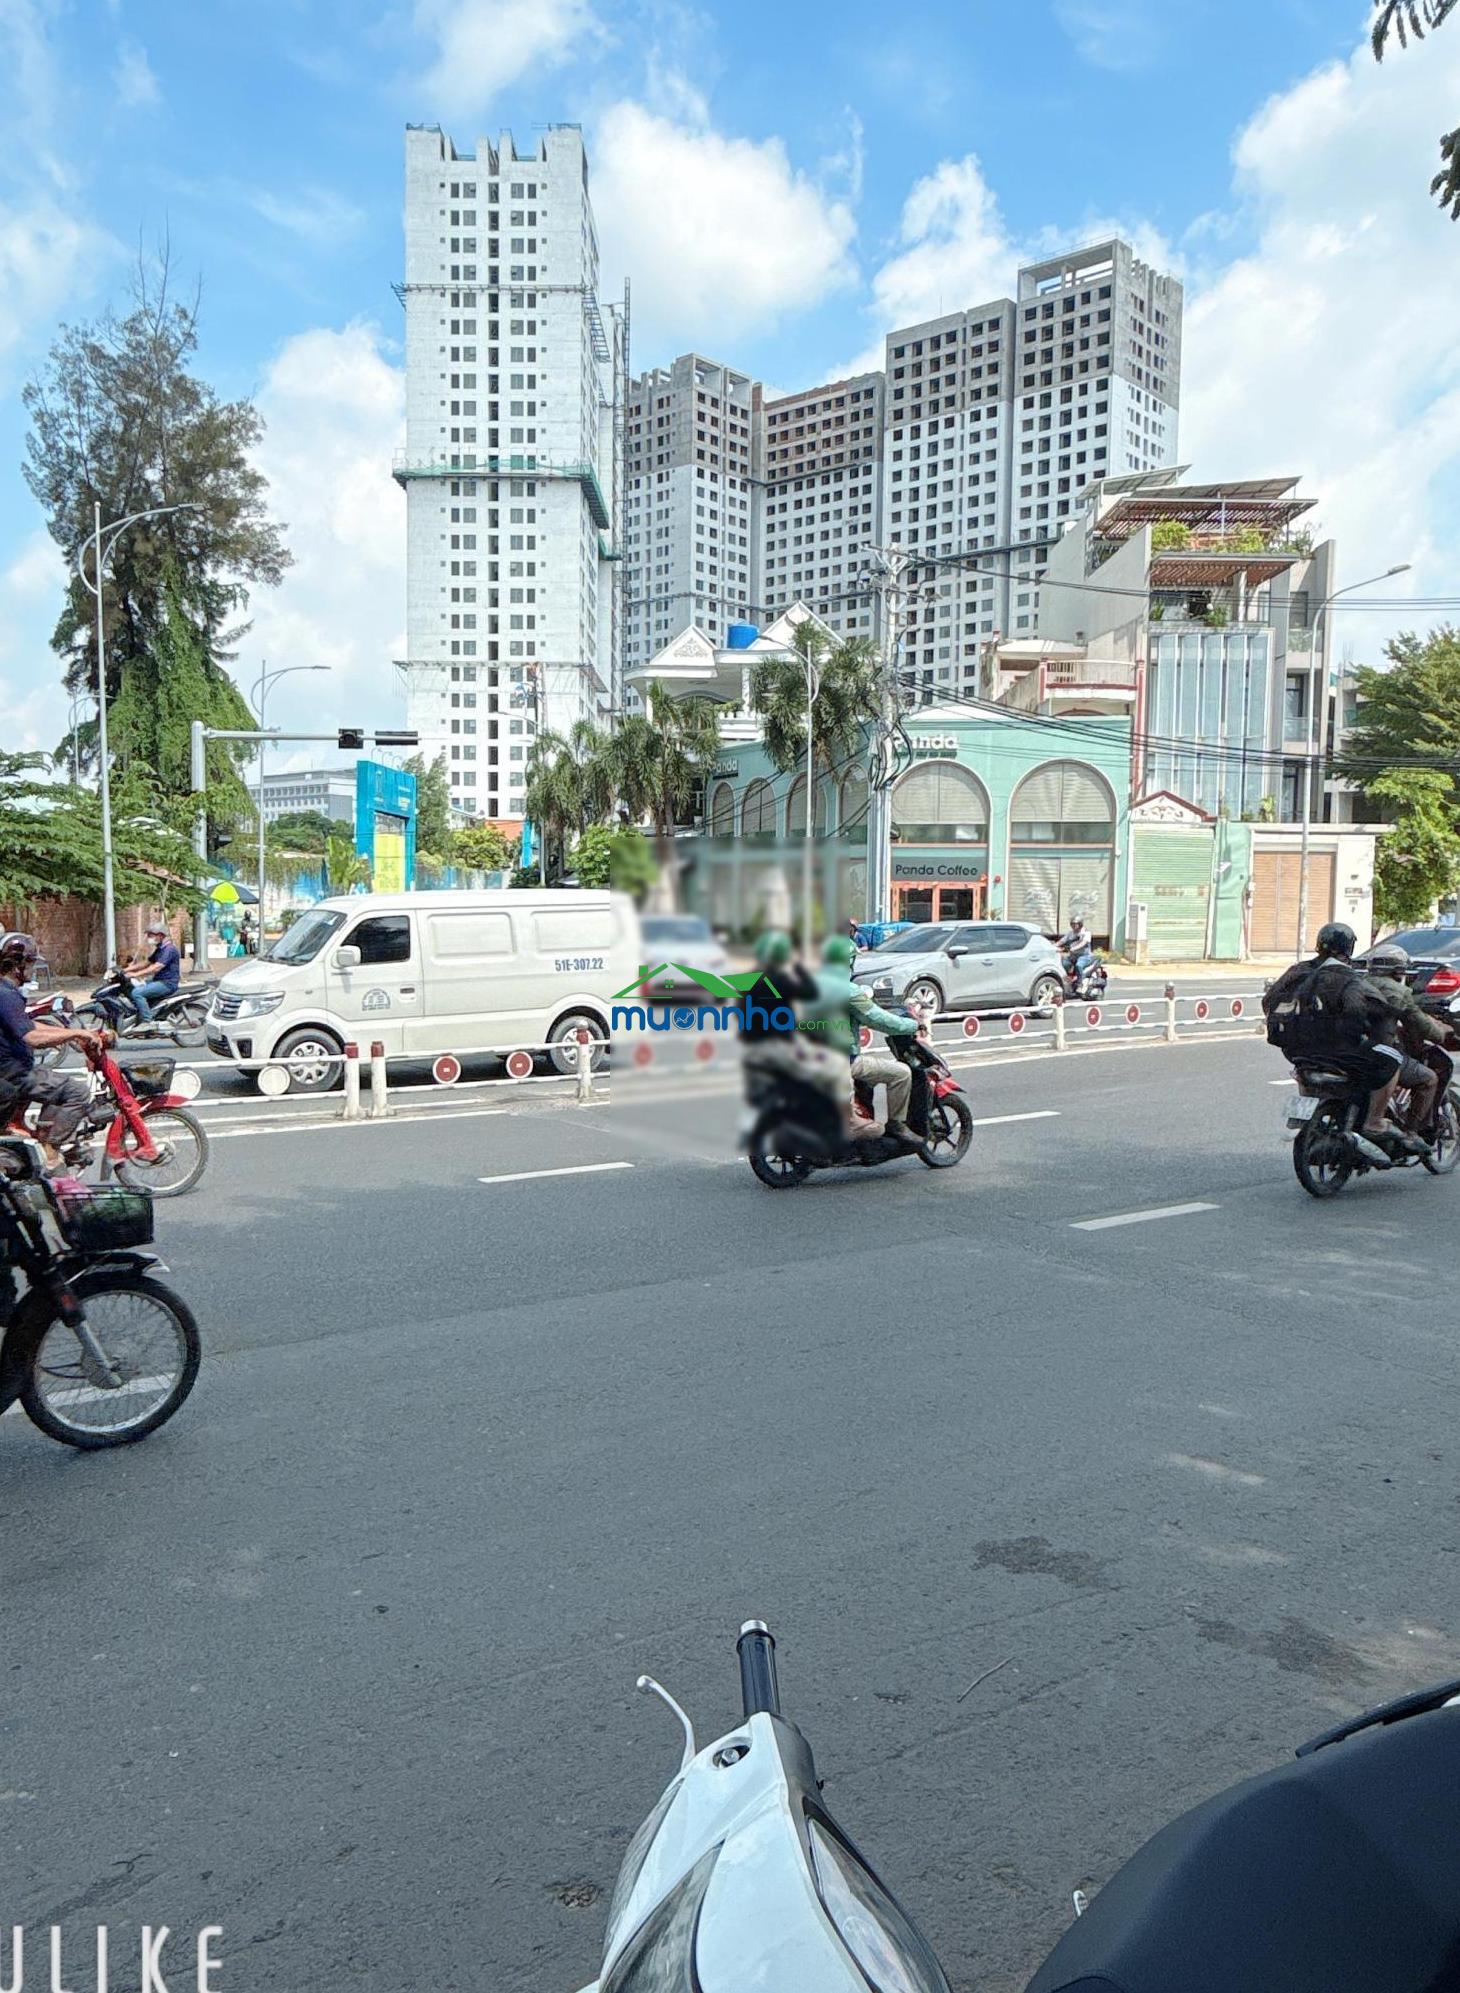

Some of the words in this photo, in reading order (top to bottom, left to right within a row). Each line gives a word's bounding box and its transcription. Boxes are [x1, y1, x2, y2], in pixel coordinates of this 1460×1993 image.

[895, 864, 934, 876] Panda
[937, 864, 978, 876] Coffee
[555, 957, 604, 971] 51E-307.22
